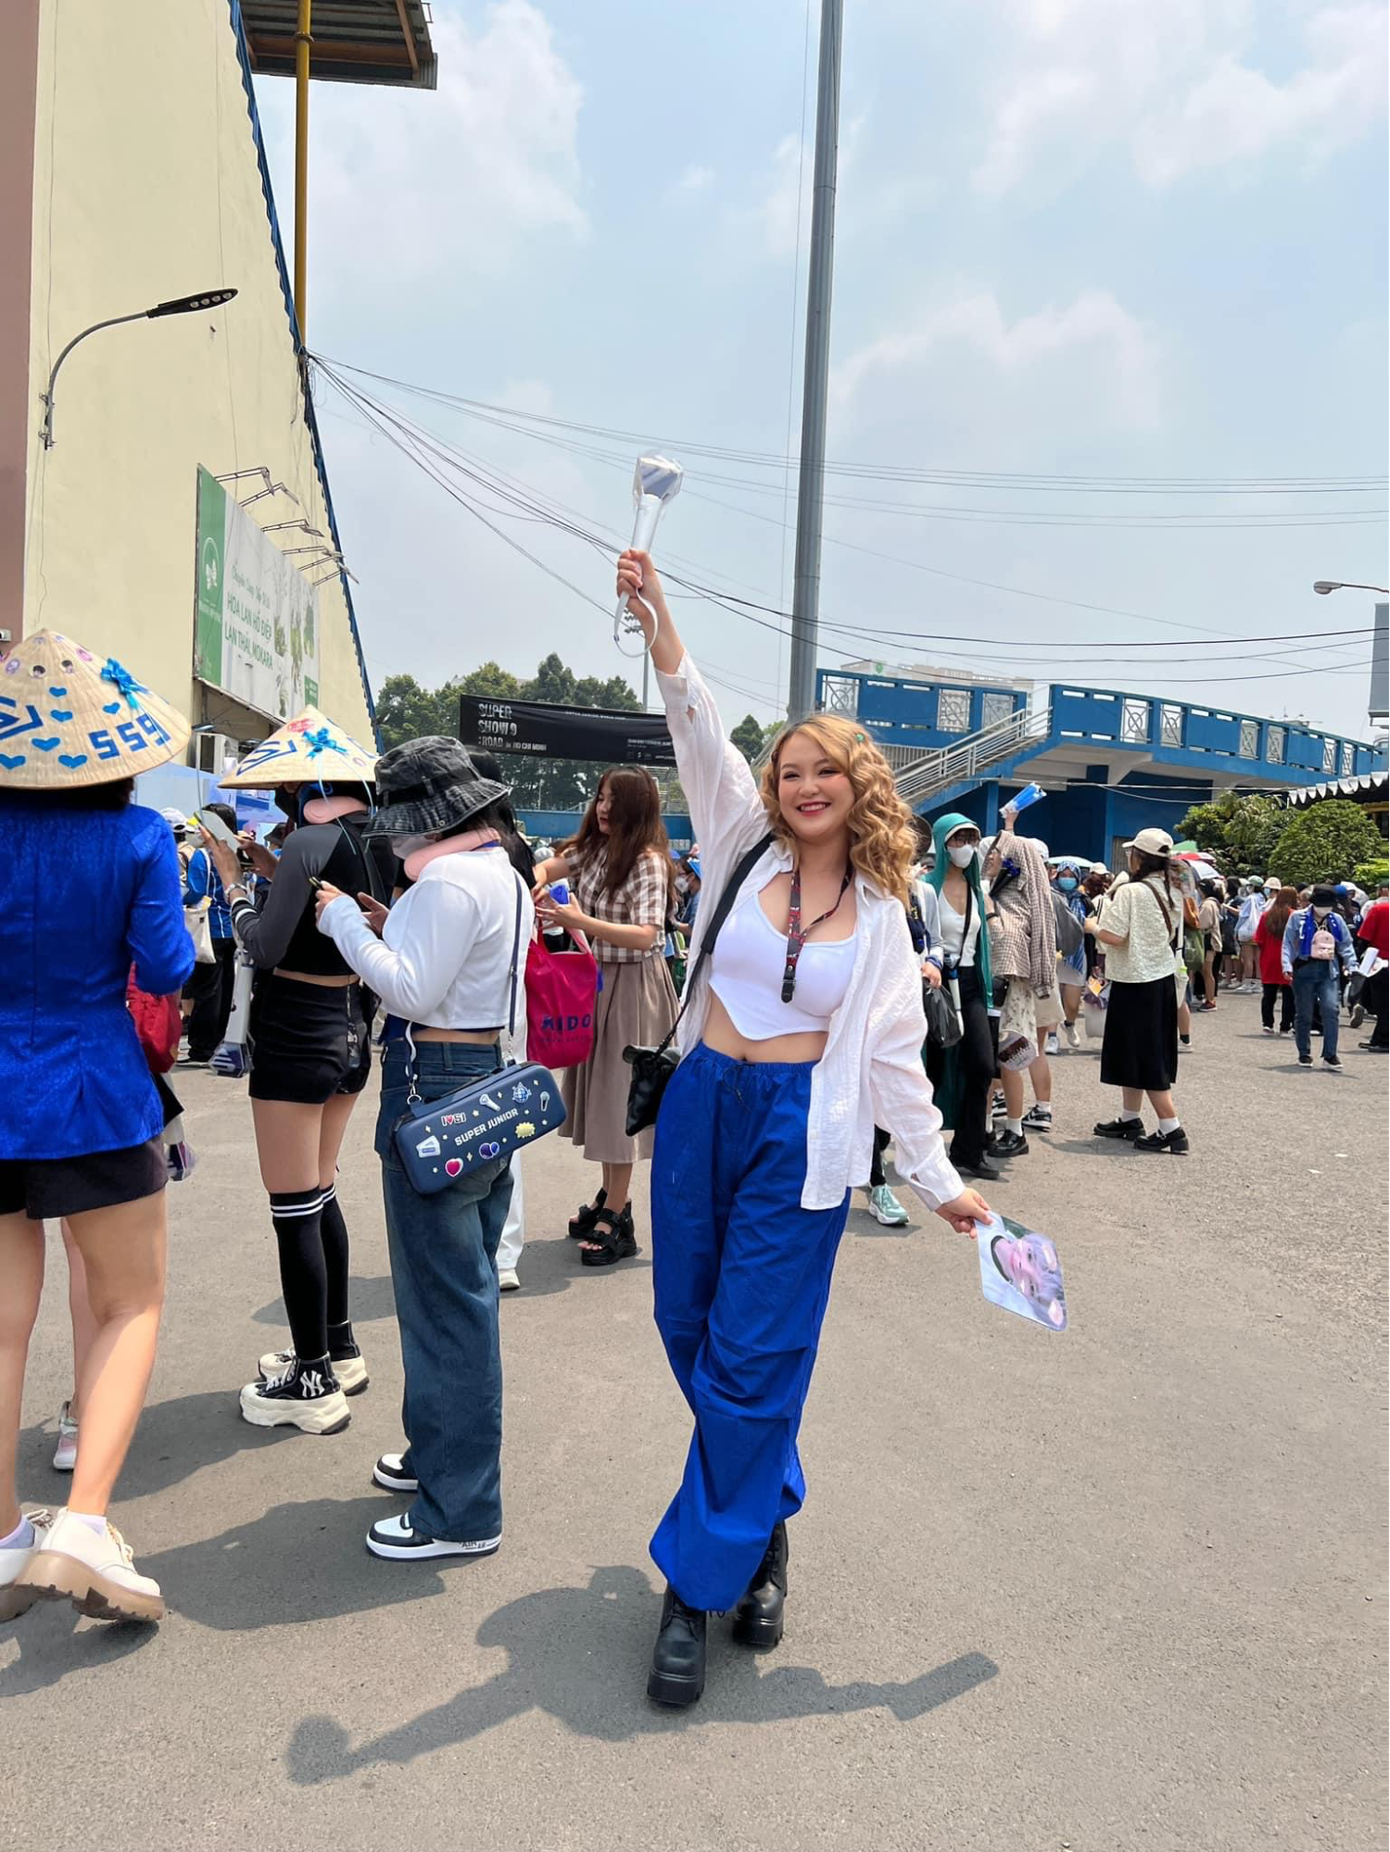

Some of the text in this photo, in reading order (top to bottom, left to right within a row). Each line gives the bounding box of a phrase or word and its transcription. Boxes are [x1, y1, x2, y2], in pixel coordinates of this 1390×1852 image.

[227, 593, 240, 618] HOA
[241, 603, 252, 627] LAN
[224, 621, 237, 646] LAN
[478, 703, 513, 719] SUPER
[477, 719, 518, 736] SHOW 9
[454, 1108, 519, 1146] SUPER JUNIOR
[299, 1370, 325, 1398] NY
